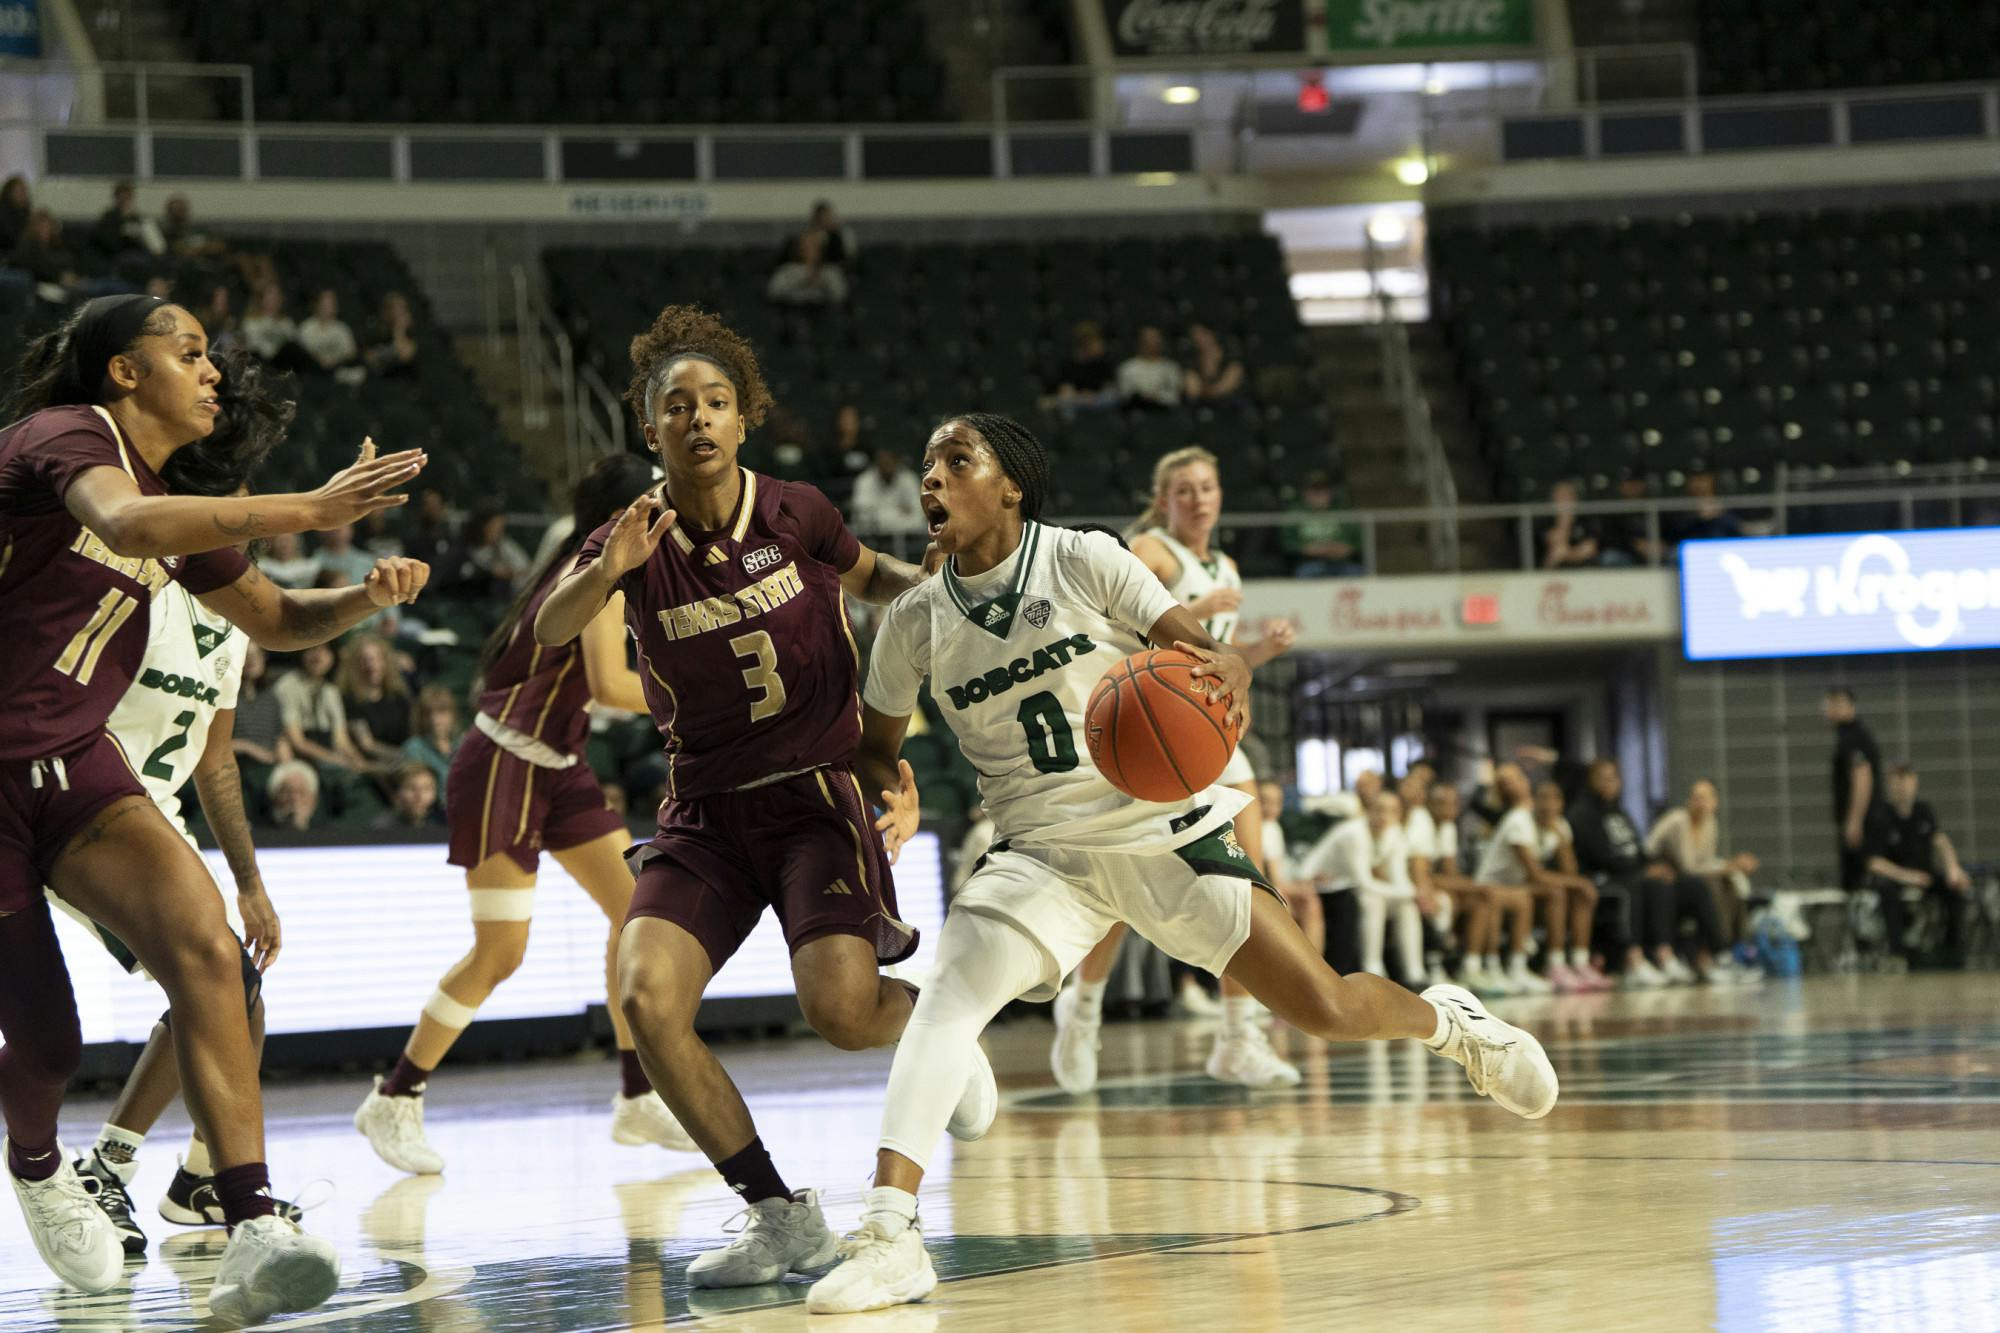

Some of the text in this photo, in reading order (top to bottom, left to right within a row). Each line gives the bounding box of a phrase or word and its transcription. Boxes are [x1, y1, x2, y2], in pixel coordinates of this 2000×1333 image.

[742, 544, 782, 574] SBC
[53, 587, 139, 686] 11
[657, 560, 805, 641] TEXAS STATE
[984, 610, 1011, 628] adidas
[729, 630, 787, 723] 3
[945, 633, 1097, 711] BOBCATS
[142, 710, 196, 782] 2
[1017, 690, 1080, 774] 0
